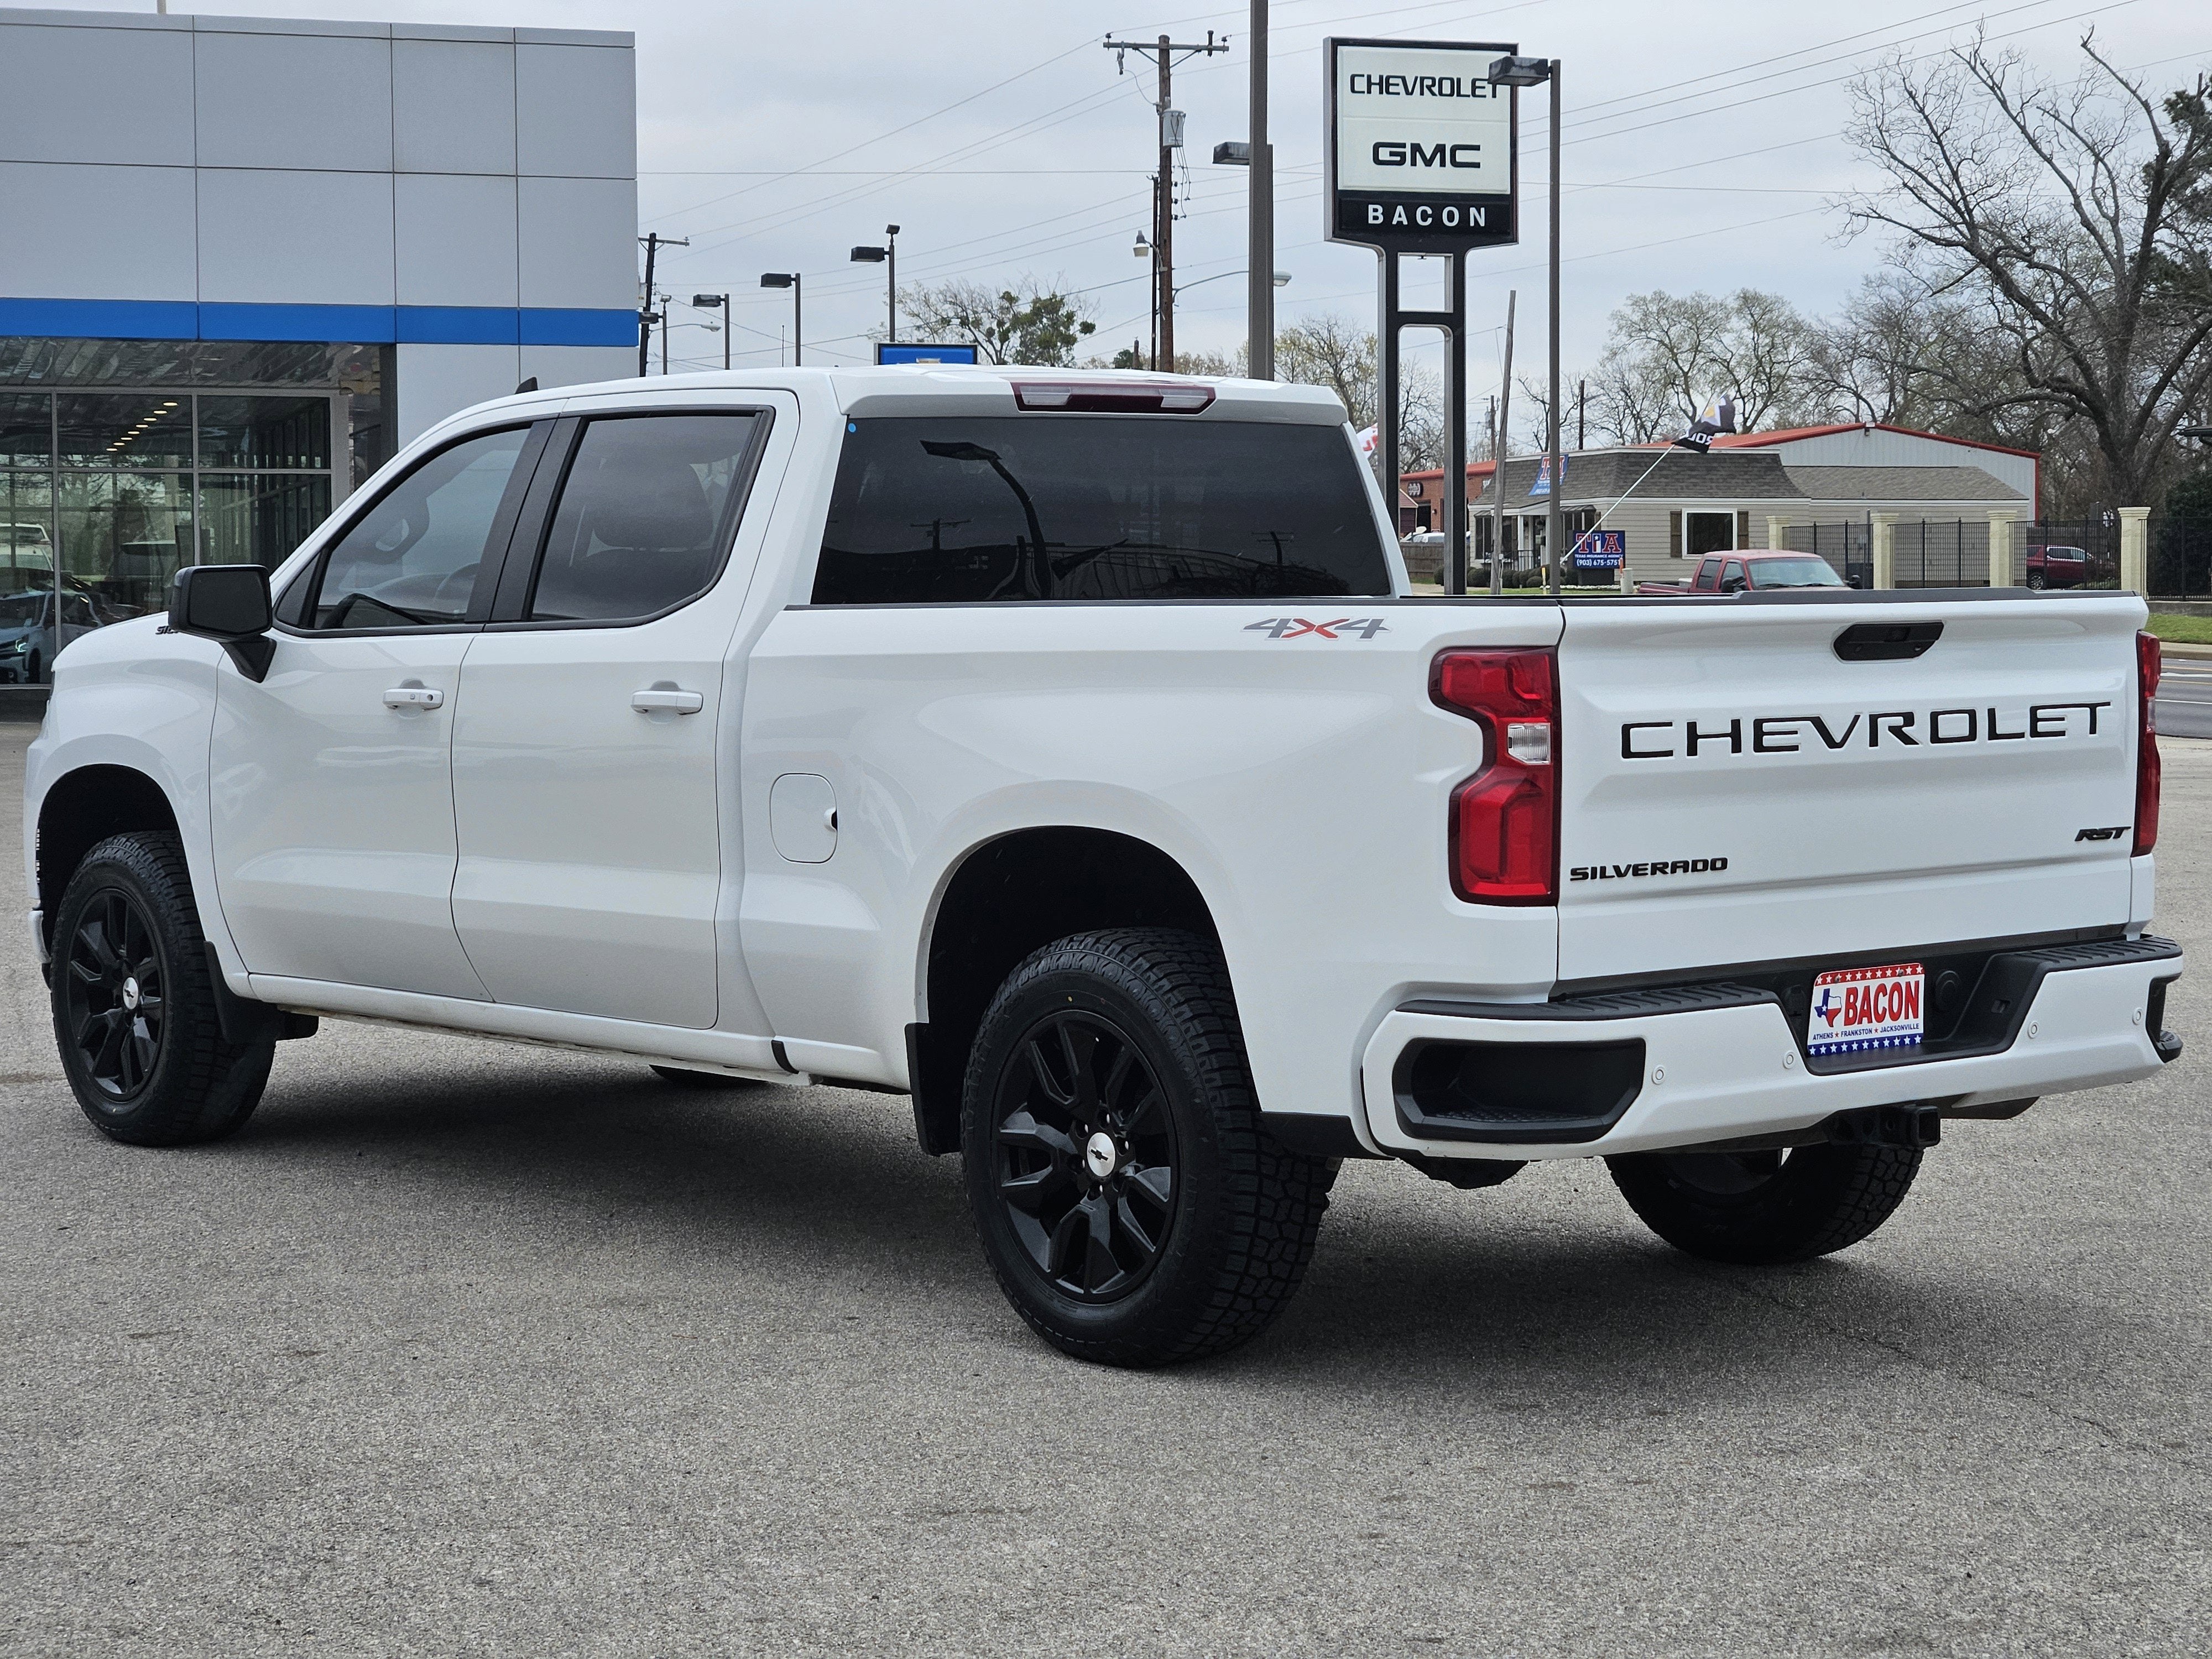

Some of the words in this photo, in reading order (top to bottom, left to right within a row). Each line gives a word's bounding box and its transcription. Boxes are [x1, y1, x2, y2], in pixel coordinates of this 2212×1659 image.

[1372, 141, 1481, 168] GMC
[1368, 204, 1486, 227] BACON
[1577, 559, 1592, 567] (903)
[1621, 701, 2111, 759] CHEVROLET
[2074, 826, 2132, 842] RST
[1570, 857, 1728, 881] SILVERADO
[1843, 980, 1920, 1027] BACON
[1812, 1032, 1834, 1041] ATHENS
[1840, 1027, 1873, 1038] FRANKSTON
[1880, 1023, 1919, 1033] JACKSONVILLE
